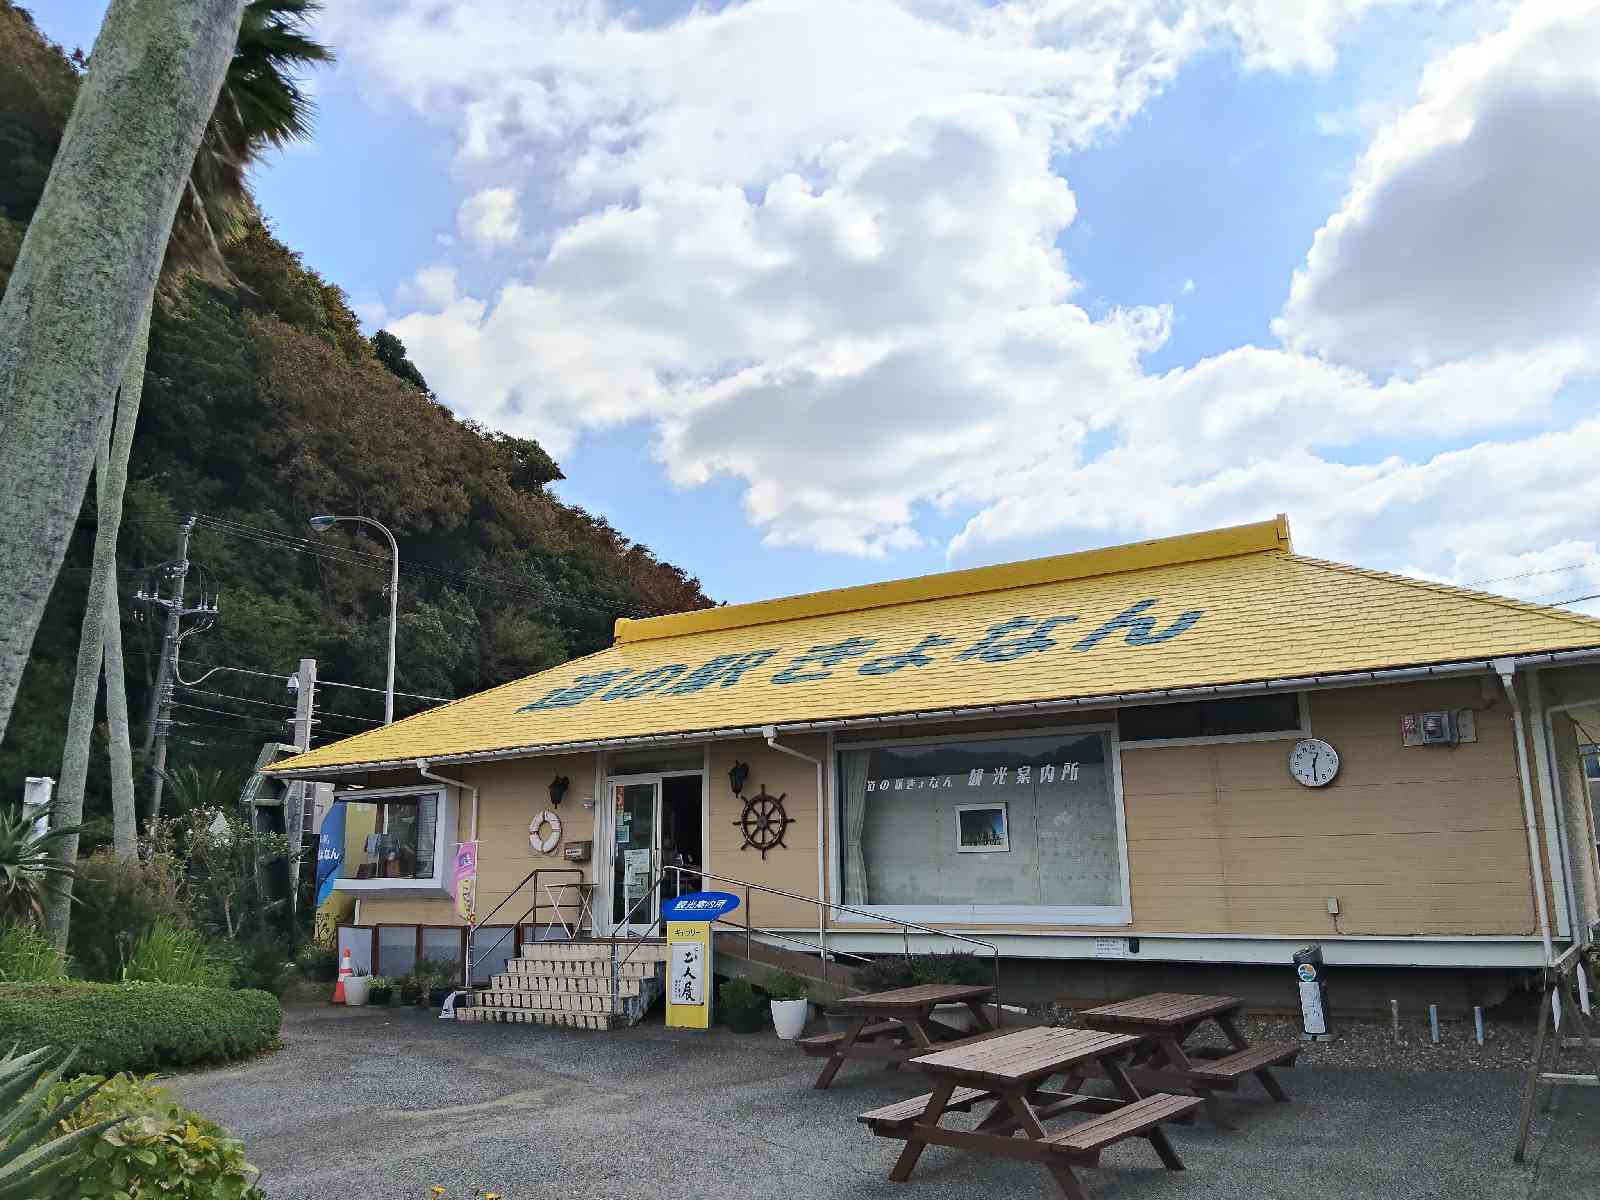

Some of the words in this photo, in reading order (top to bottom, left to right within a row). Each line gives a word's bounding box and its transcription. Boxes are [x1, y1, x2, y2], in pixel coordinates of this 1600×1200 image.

[967, 762, 1080, 787] 観光案内所
